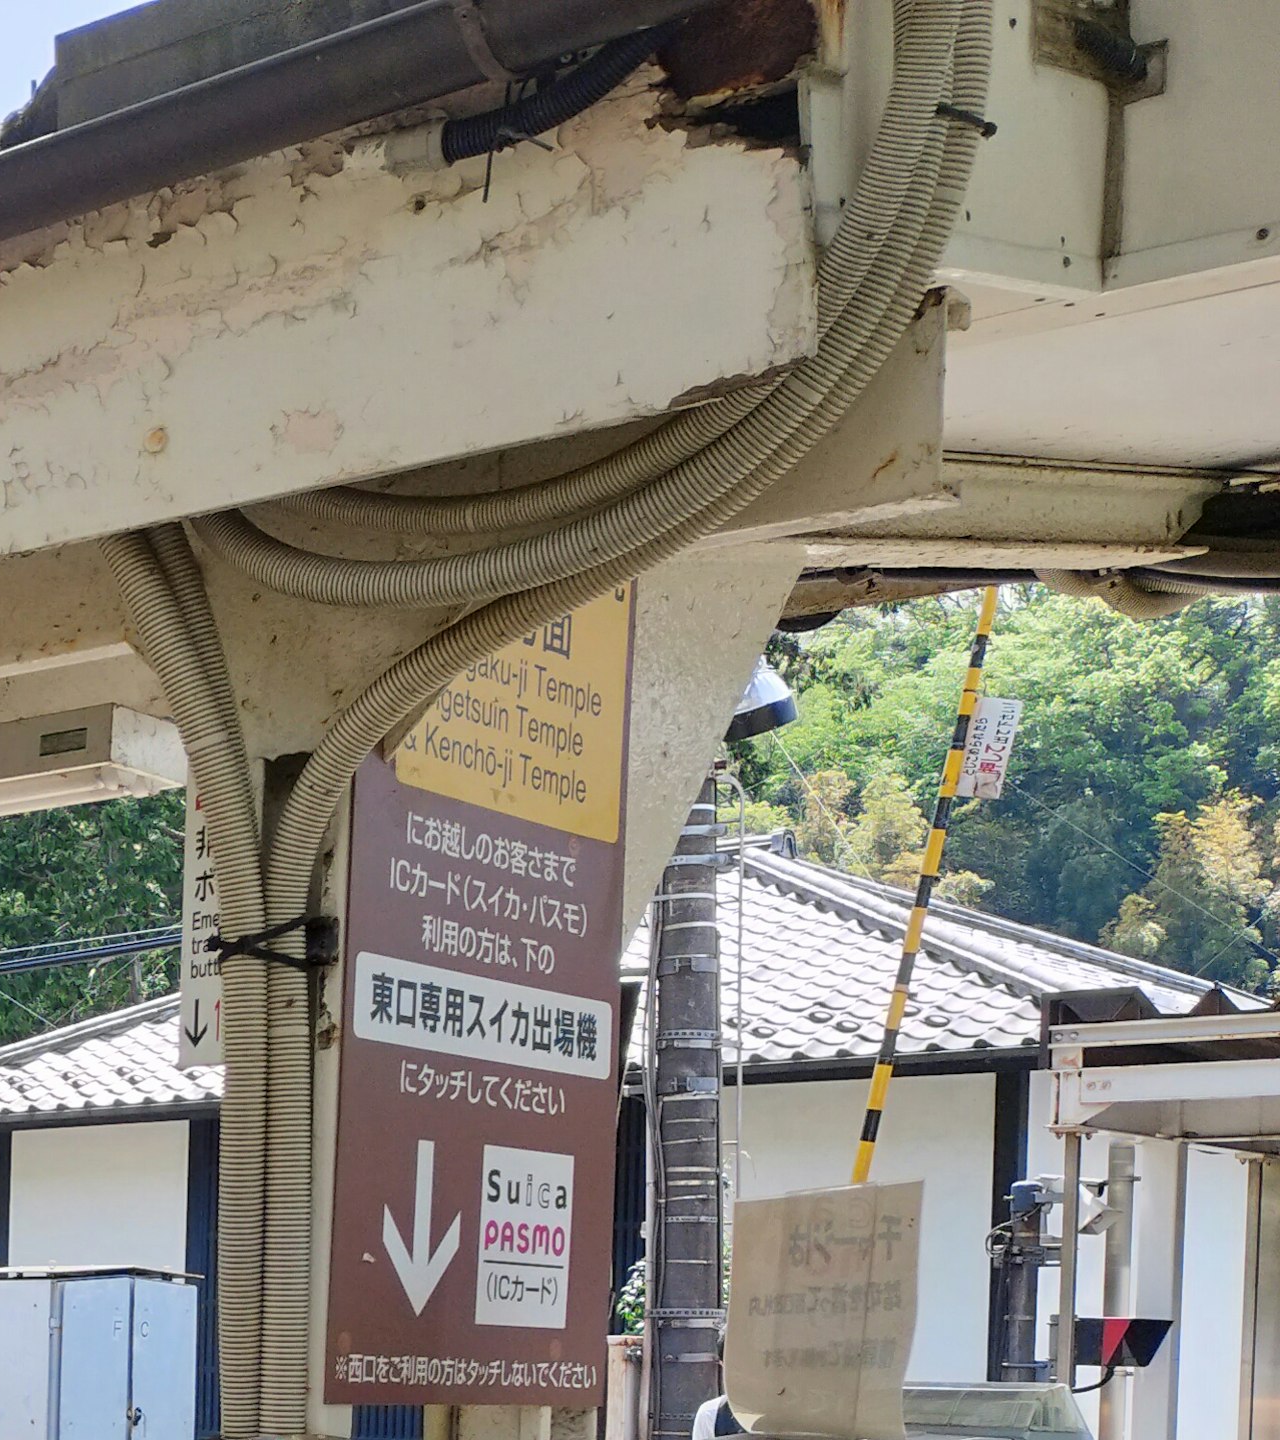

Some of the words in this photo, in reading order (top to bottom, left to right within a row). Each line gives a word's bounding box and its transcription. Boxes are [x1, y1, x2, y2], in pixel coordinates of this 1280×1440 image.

[534, 664, 602, 718] Temple
[516, 704, 584, 758] Temple
[425, 722, 513, 788] Kenchō-ji
[520, 752, 586, 804] Temple
[406, 812, 576, 889] にお越しのお客さまで
[421, 914, 556, 976] 利用の方は、下の
[370, 971, 599, 1063] 東口専用スイカ出場機
[400, 1059, 565, 1115] にタッチしてください
[487, 1168, 568, 1211] Suica
[484, 1219, 566, 1258] PASMO
[486, 1271, 559, 1305] (ICカード)
